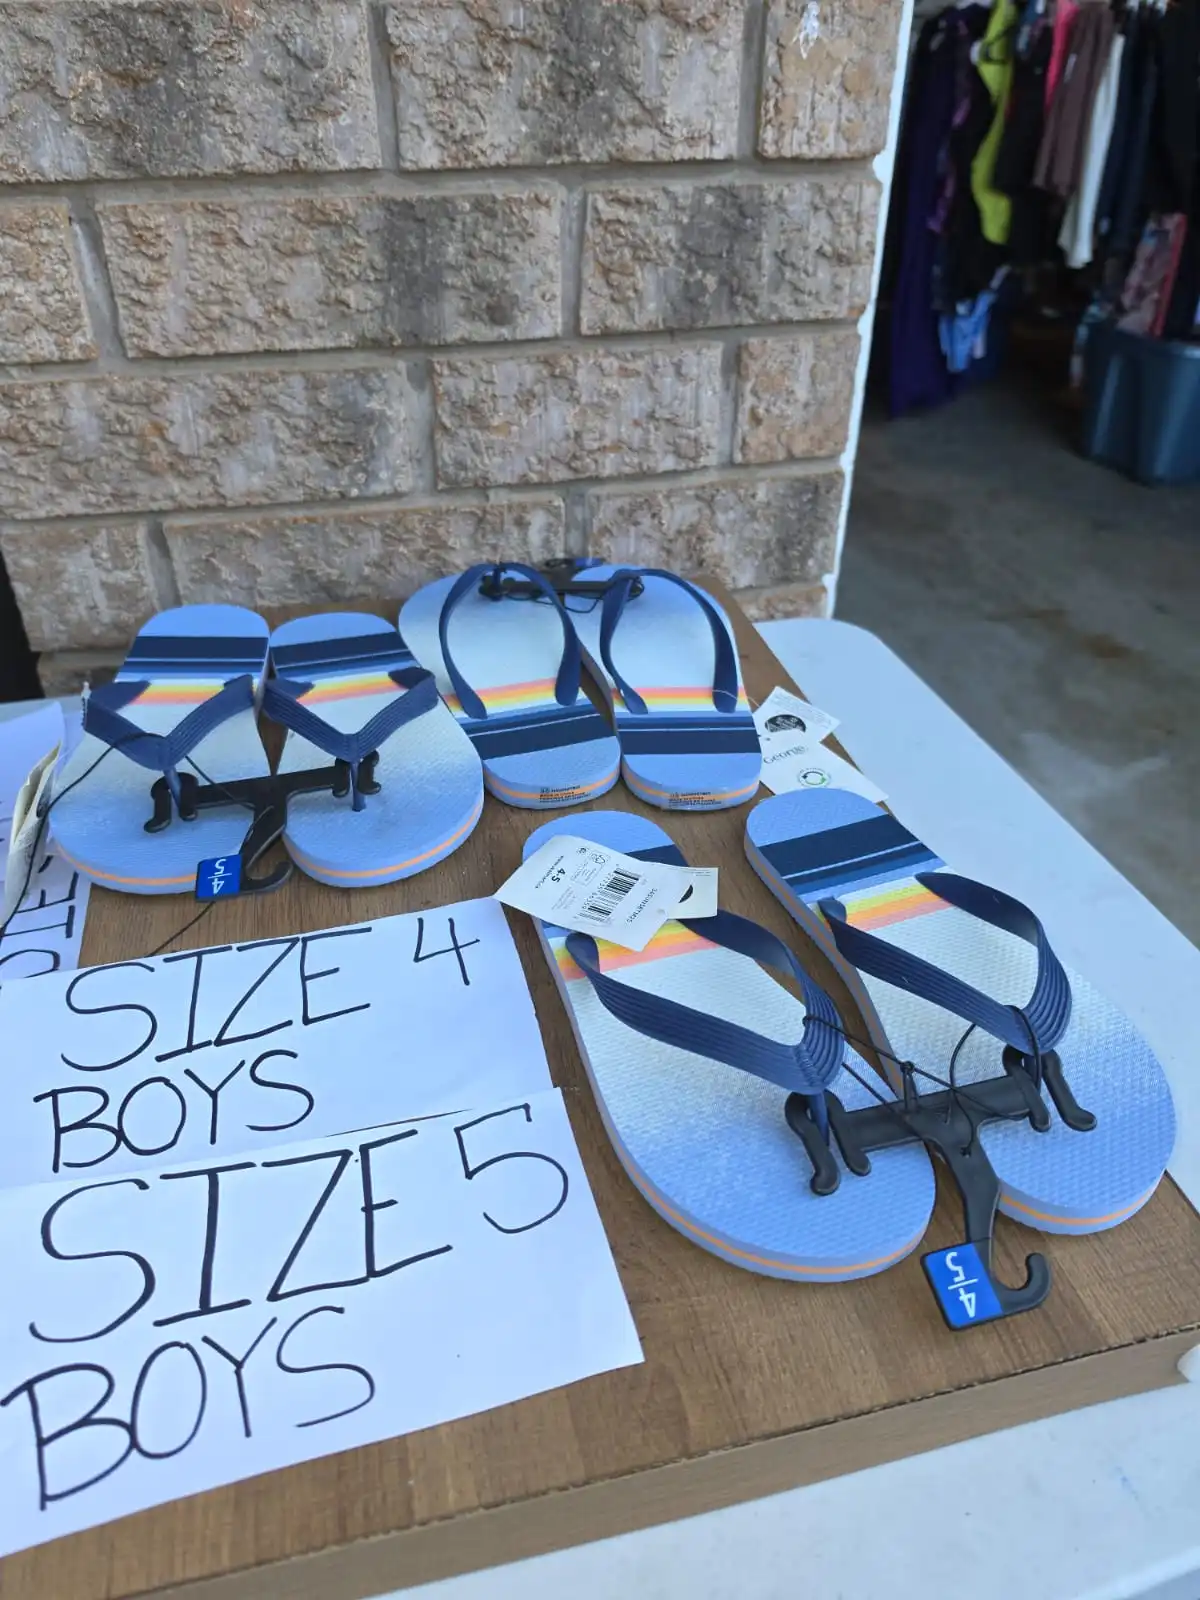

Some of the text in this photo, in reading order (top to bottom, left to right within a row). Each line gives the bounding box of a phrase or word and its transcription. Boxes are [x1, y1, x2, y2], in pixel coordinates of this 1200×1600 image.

[60, 917, 480, 1072] SIZE 4
[33, 1049, 315, 1173] BOYS
[29, 1102, 569, 1343] SIZE 5
[0, 1305, 376, 1512] BOYS
